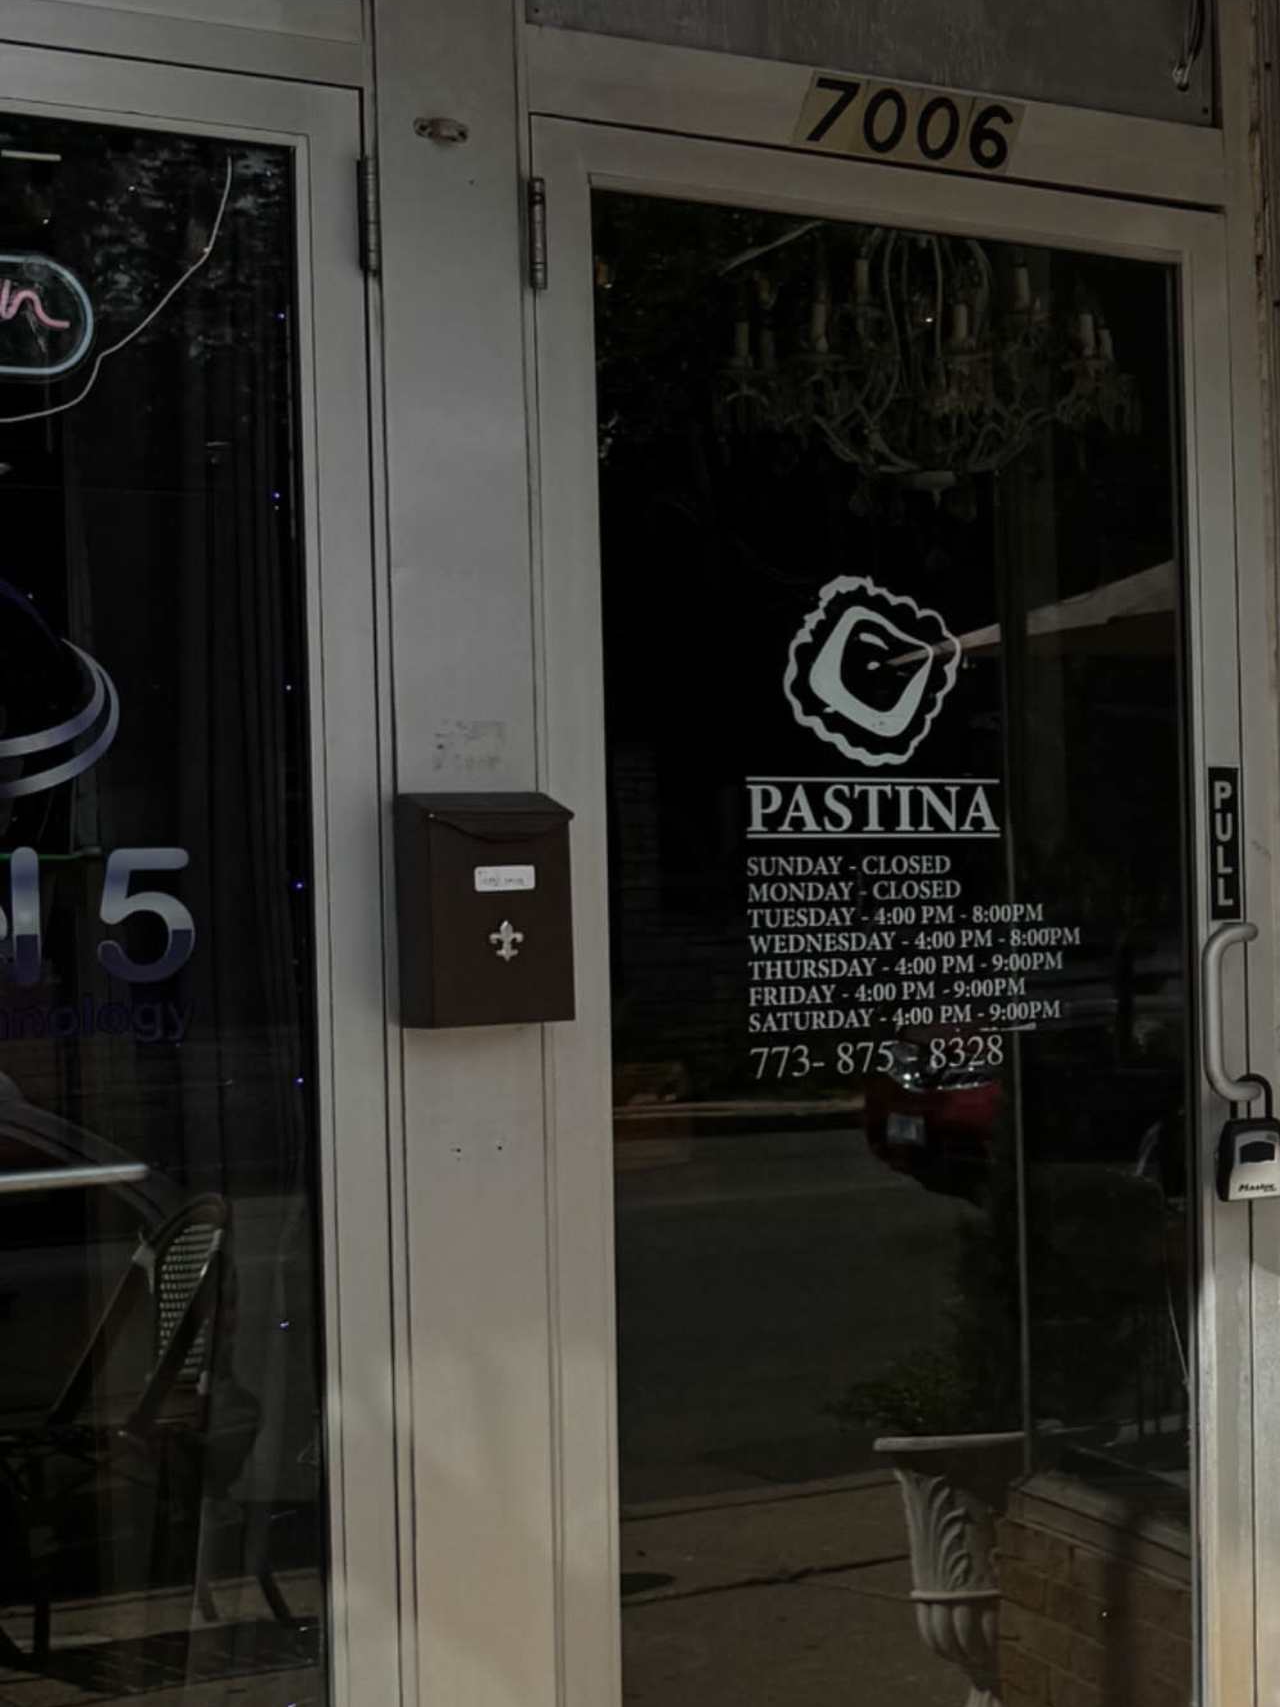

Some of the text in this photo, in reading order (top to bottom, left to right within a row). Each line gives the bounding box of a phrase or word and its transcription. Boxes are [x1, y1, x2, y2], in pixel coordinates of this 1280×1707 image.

[806, 77, 1014, 171] 7006
[746, 783, 1001, 832] PASTINA
[1213, 780, 1235, 906] PULL
[747, 856, 843, 877] SUNDAY
[861, 854, 951, 875] CLOSED
[748, 881, 854, 903] MONDAY
[872, 879, 962, 900] CLOSED
[97, 846, 198, 984] 5
[747, 907, 856, 929] TUESDAY
[874, 906, 916, 925] 4:00
[921, 905, 955, 925] PM
[972, 903, 1044, 924] 8:00PM
[748, 931, 896, 954] WEDNESDAY
[914, 931, 956, 950] 4:00
[960, 929, 993, 948] PM
[1009, 927, 1081, 947] 8:00PM
[747, 957, 877, 981] THURSDAY
[894, 956, 937, 975] 4:00
[941, 954, 974, 974] PM
[991, 951, 1063, 972] 9:00PM
[749, 984, 836, 1007] FRIDAY
[854, 982, 896, 1002] 4:00
[901, 980, 935, 1001] PM
[748, 1009, 874, 1033] SATURDAY
[892, 1006, 934, 1028] 4:00
[940, 1004, 972, 1024] PM
[989, 1000, 1060, 1021] 9:00PM
[836, 1040, 897, 1076] 875
[929, 1034, 1004, 1071] 8328
